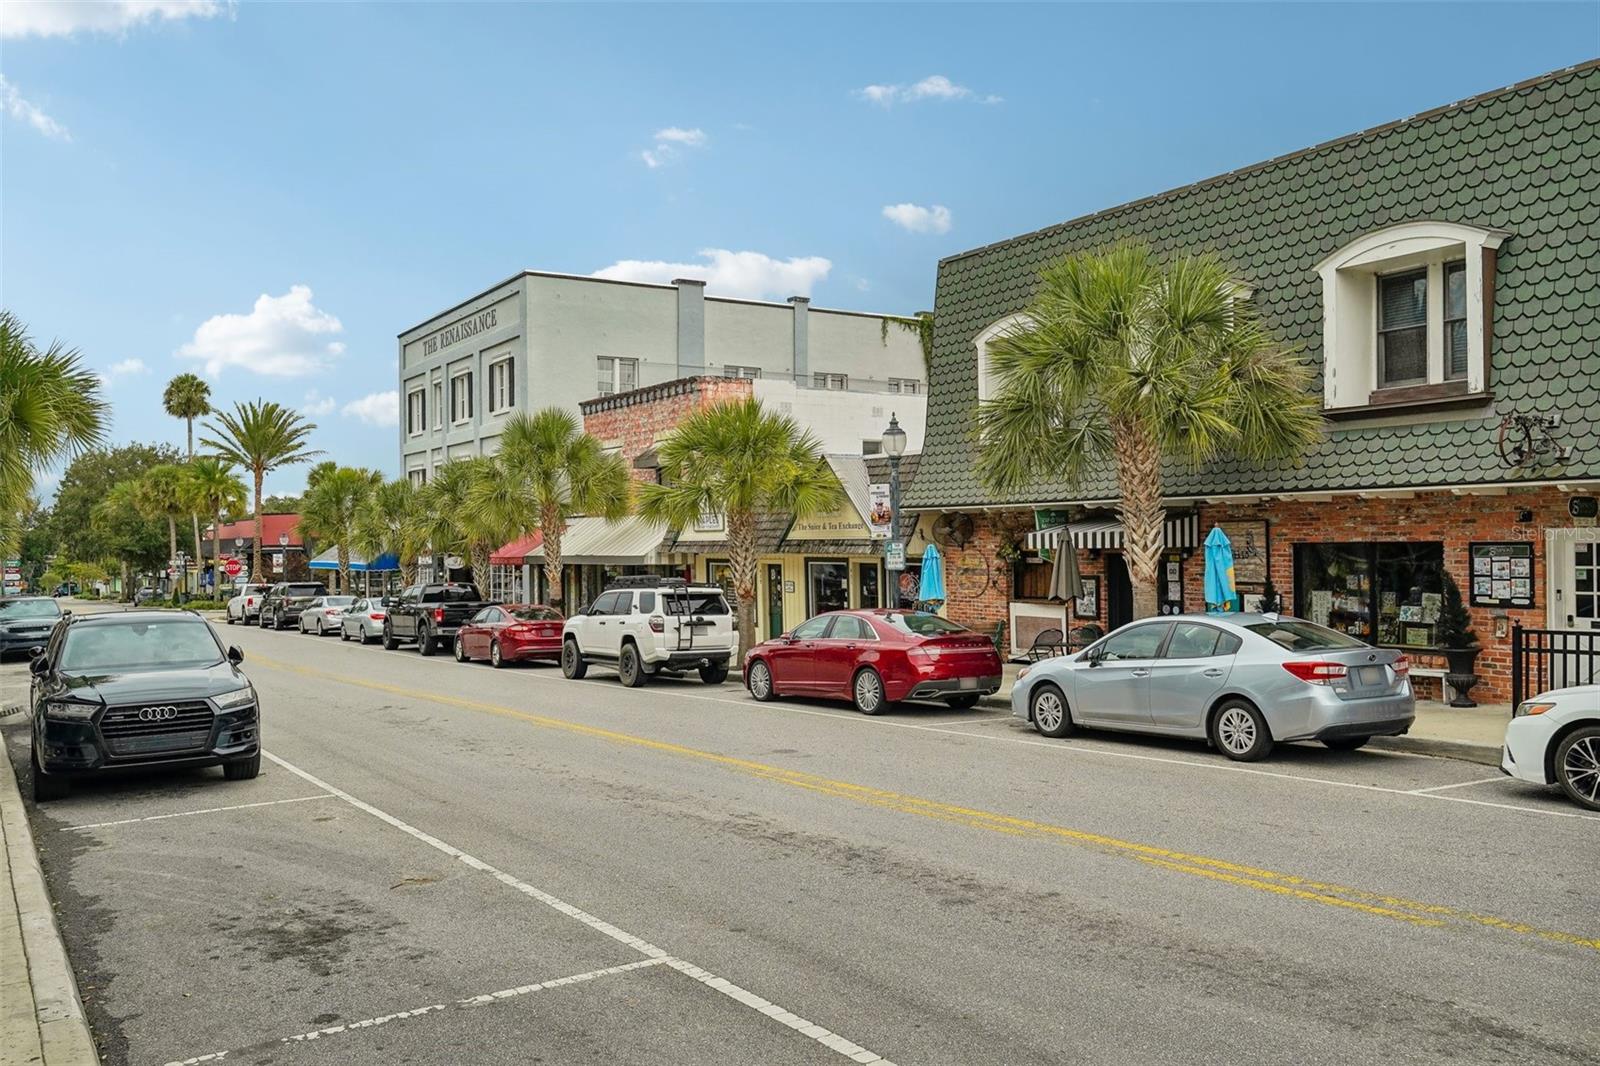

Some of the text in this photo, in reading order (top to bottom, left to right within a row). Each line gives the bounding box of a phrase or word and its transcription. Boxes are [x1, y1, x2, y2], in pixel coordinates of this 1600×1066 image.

[422, 308, 497, 357] THE RENAISSANCE
[798, 523, 807, 531] The
[822, 521, 828, 530] &
[829, 522, 837, 530] Tea
[839, 521, 865, 530] Exchange
